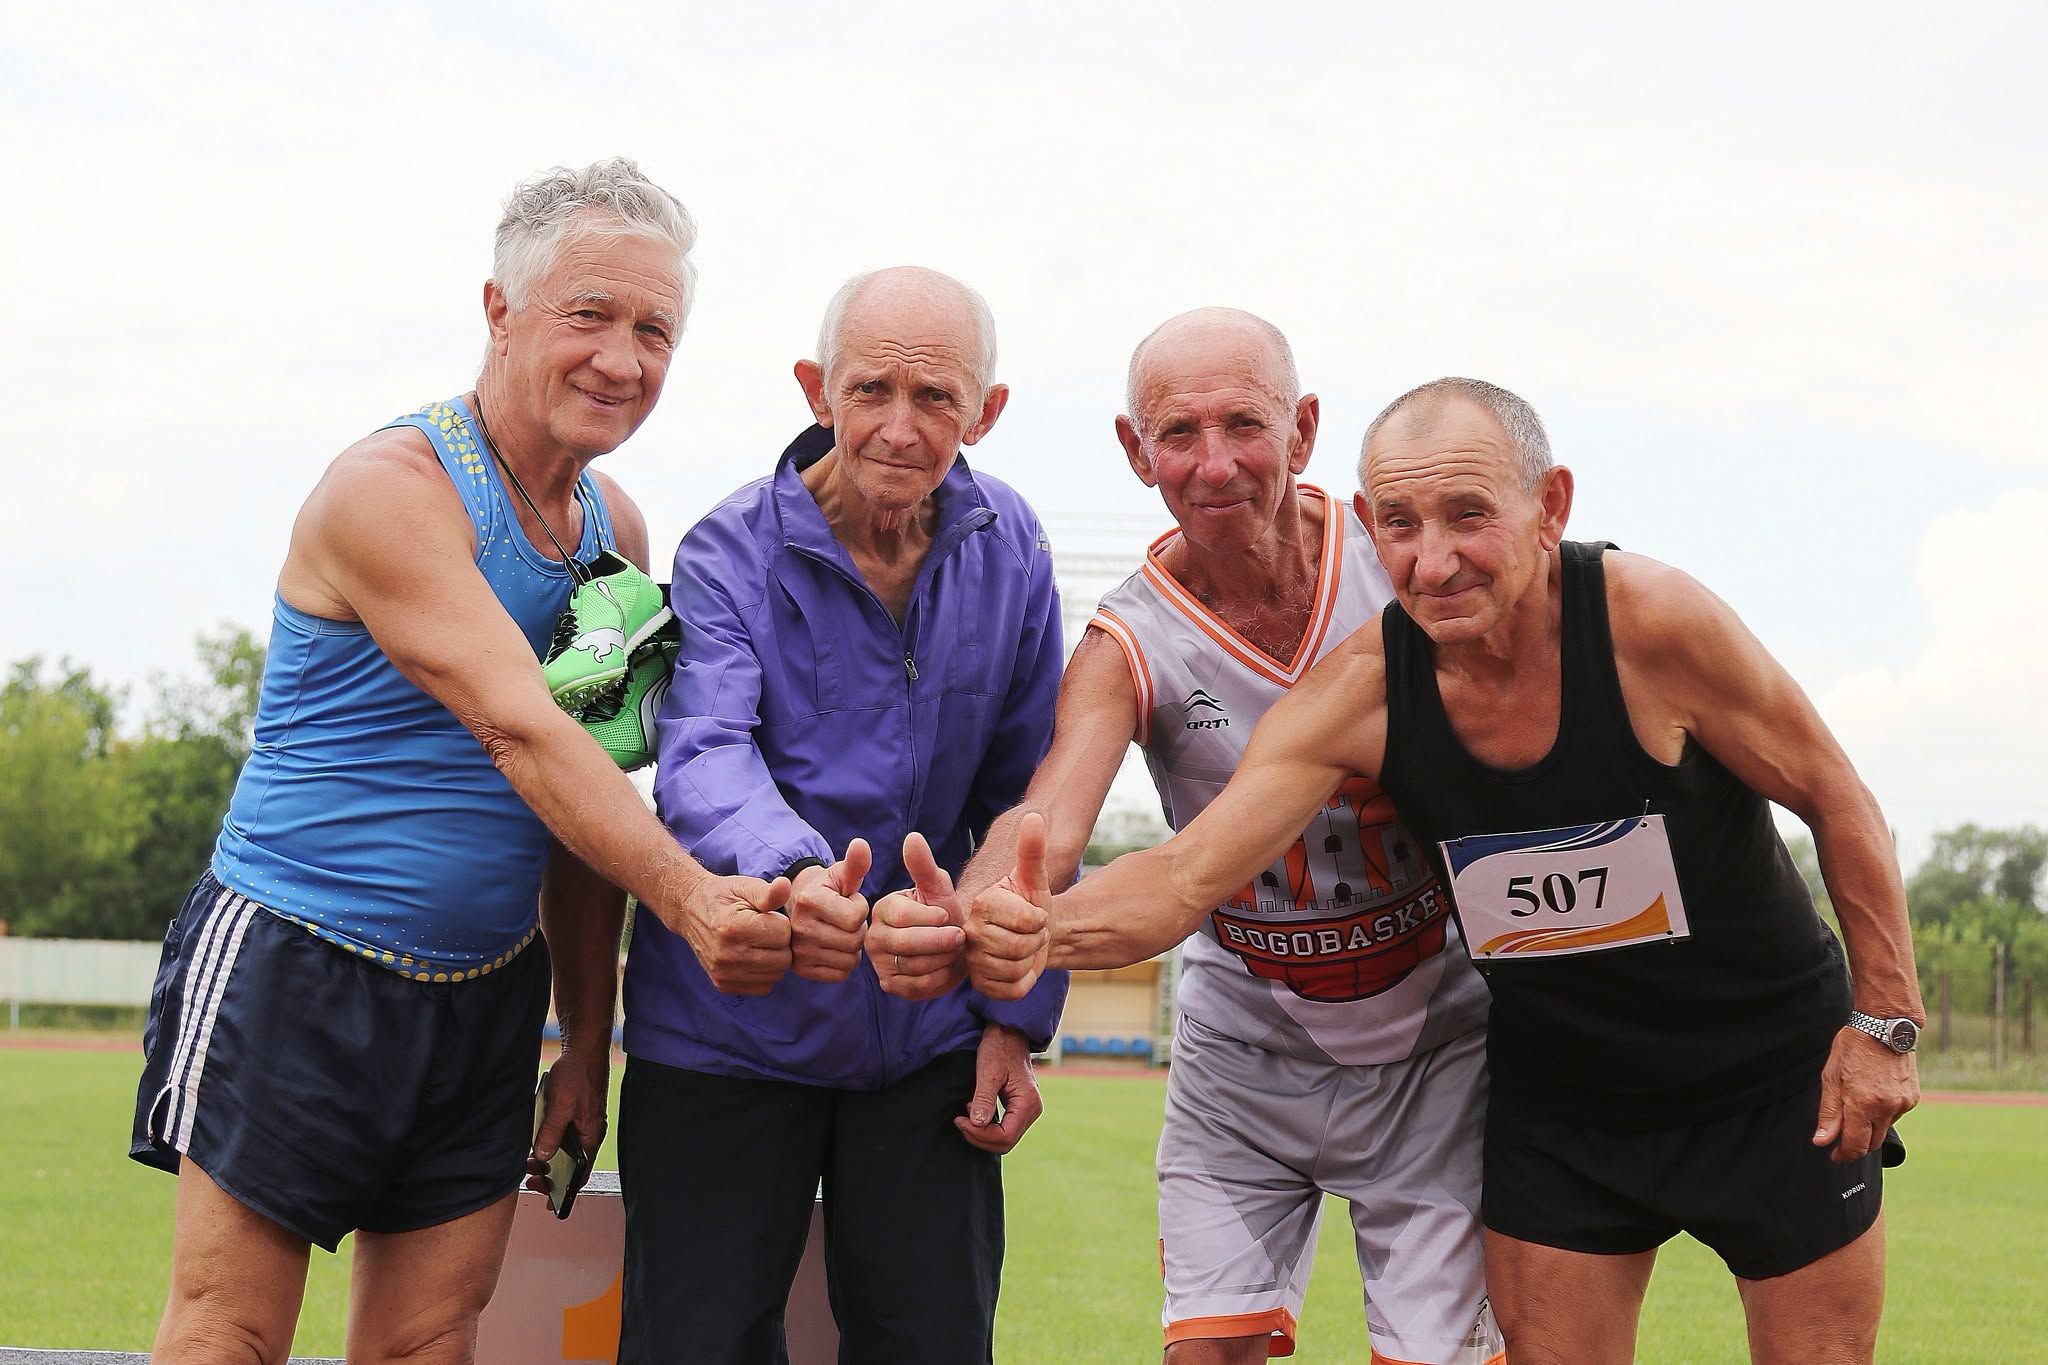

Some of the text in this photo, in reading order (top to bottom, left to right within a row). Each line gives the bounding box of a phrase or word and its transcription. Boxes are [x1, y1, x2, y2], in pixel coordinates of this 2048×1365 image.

[1506, 867, 1609, 918] 507
[1223, 885, 1446, 956] BOGOBASKE
[1841, 1182, 1866, 1200] KIPRUN
